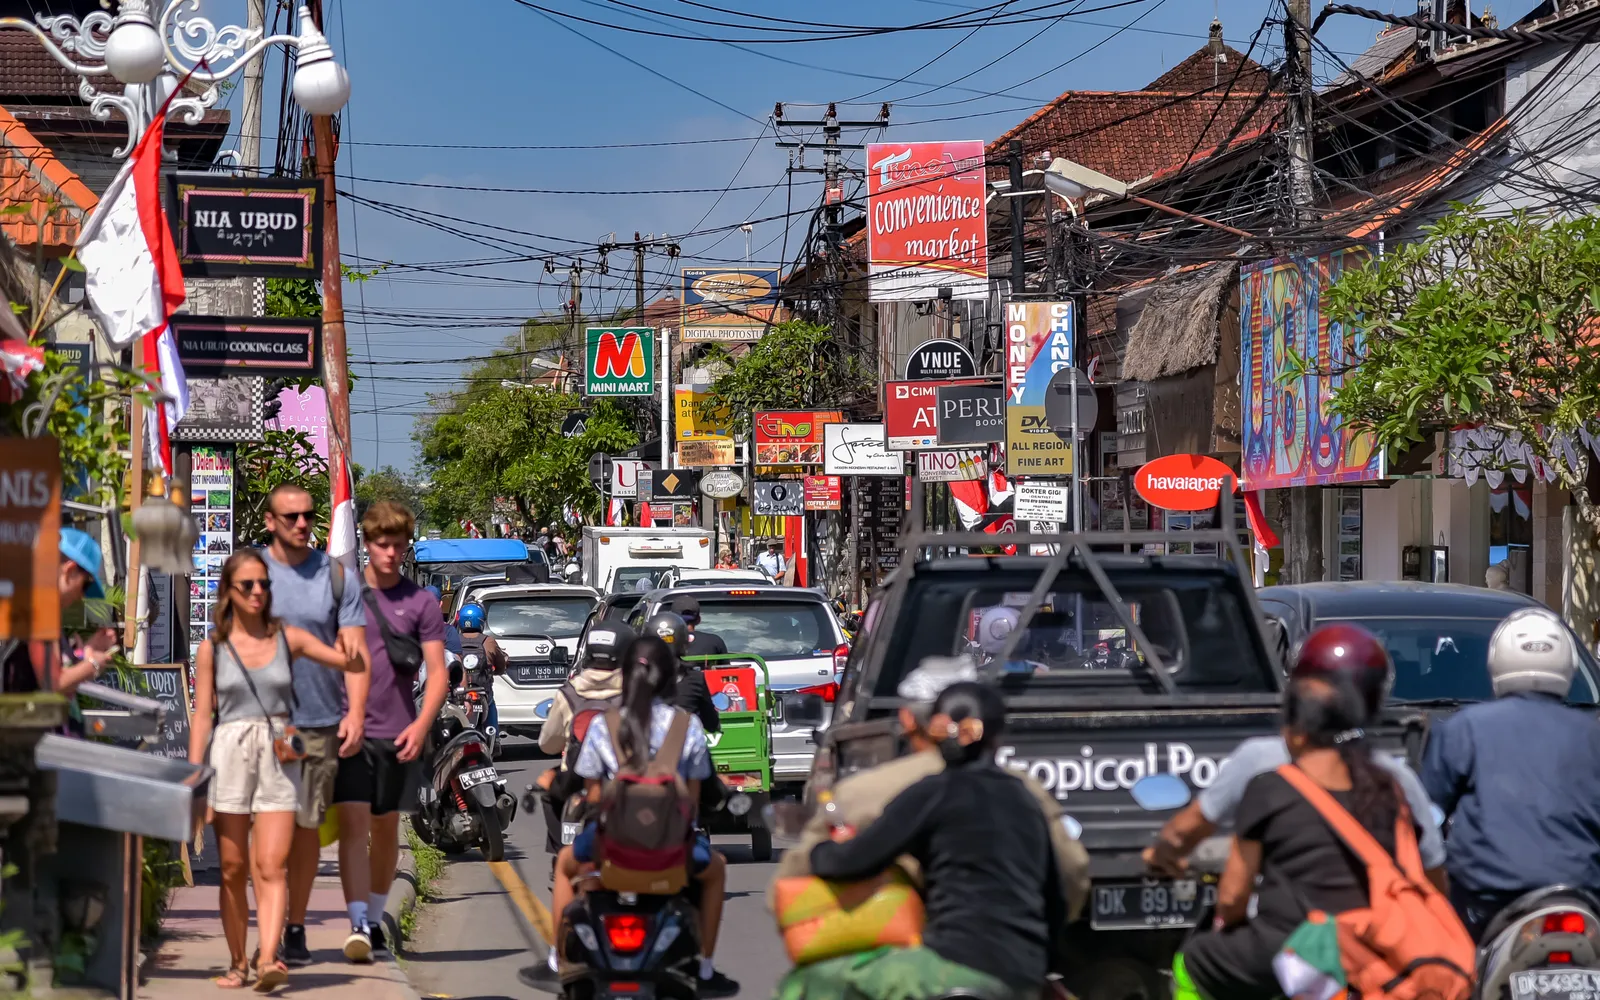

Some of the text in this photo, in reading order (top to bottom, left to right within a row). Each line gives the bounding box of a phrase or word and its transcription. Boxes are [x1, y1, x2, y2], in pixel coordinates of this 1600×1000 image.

[875, 184, 980, 235] convenience
[194, 210, 298, 230] NIA UBUD
[905, 228, 979, 266] market
[685, 329, 718, 339] DIGITAL
[718, 329, 745, 339] PHOTO
[182, 340, 198, 351] NIA
[229, 341, 273, 353] COOKING
[273, 342, 304, 354] CLASS
[1008, 304, 1027, 405] MONEY
[920, 351, 962, 368] VNUE
[590, 382, 650, 393] MINI MART
[942, 397, 1002, 420] PERI
[280, 415, 327, 423] GELATO
[975, 419, 1003, 427] BOOK
[1021, 415, 1051, 428] DV
[1011, 441, 1071, 451] ALL REGION
[919, 452, 957, 471] TINO
[1017, 457, 1065, 467] FINE ART
[202, 474, 232, 485] INFORMATION
[534, 666, 552, 676] 1936
[144, 671, 177, 698] TODAY
[1166, 742, 1214, 788] Po
[563, 825, 576, 834] DK
[1097, 888, 1127, 915] DK
[1517, 973, 1539, 995] DK
